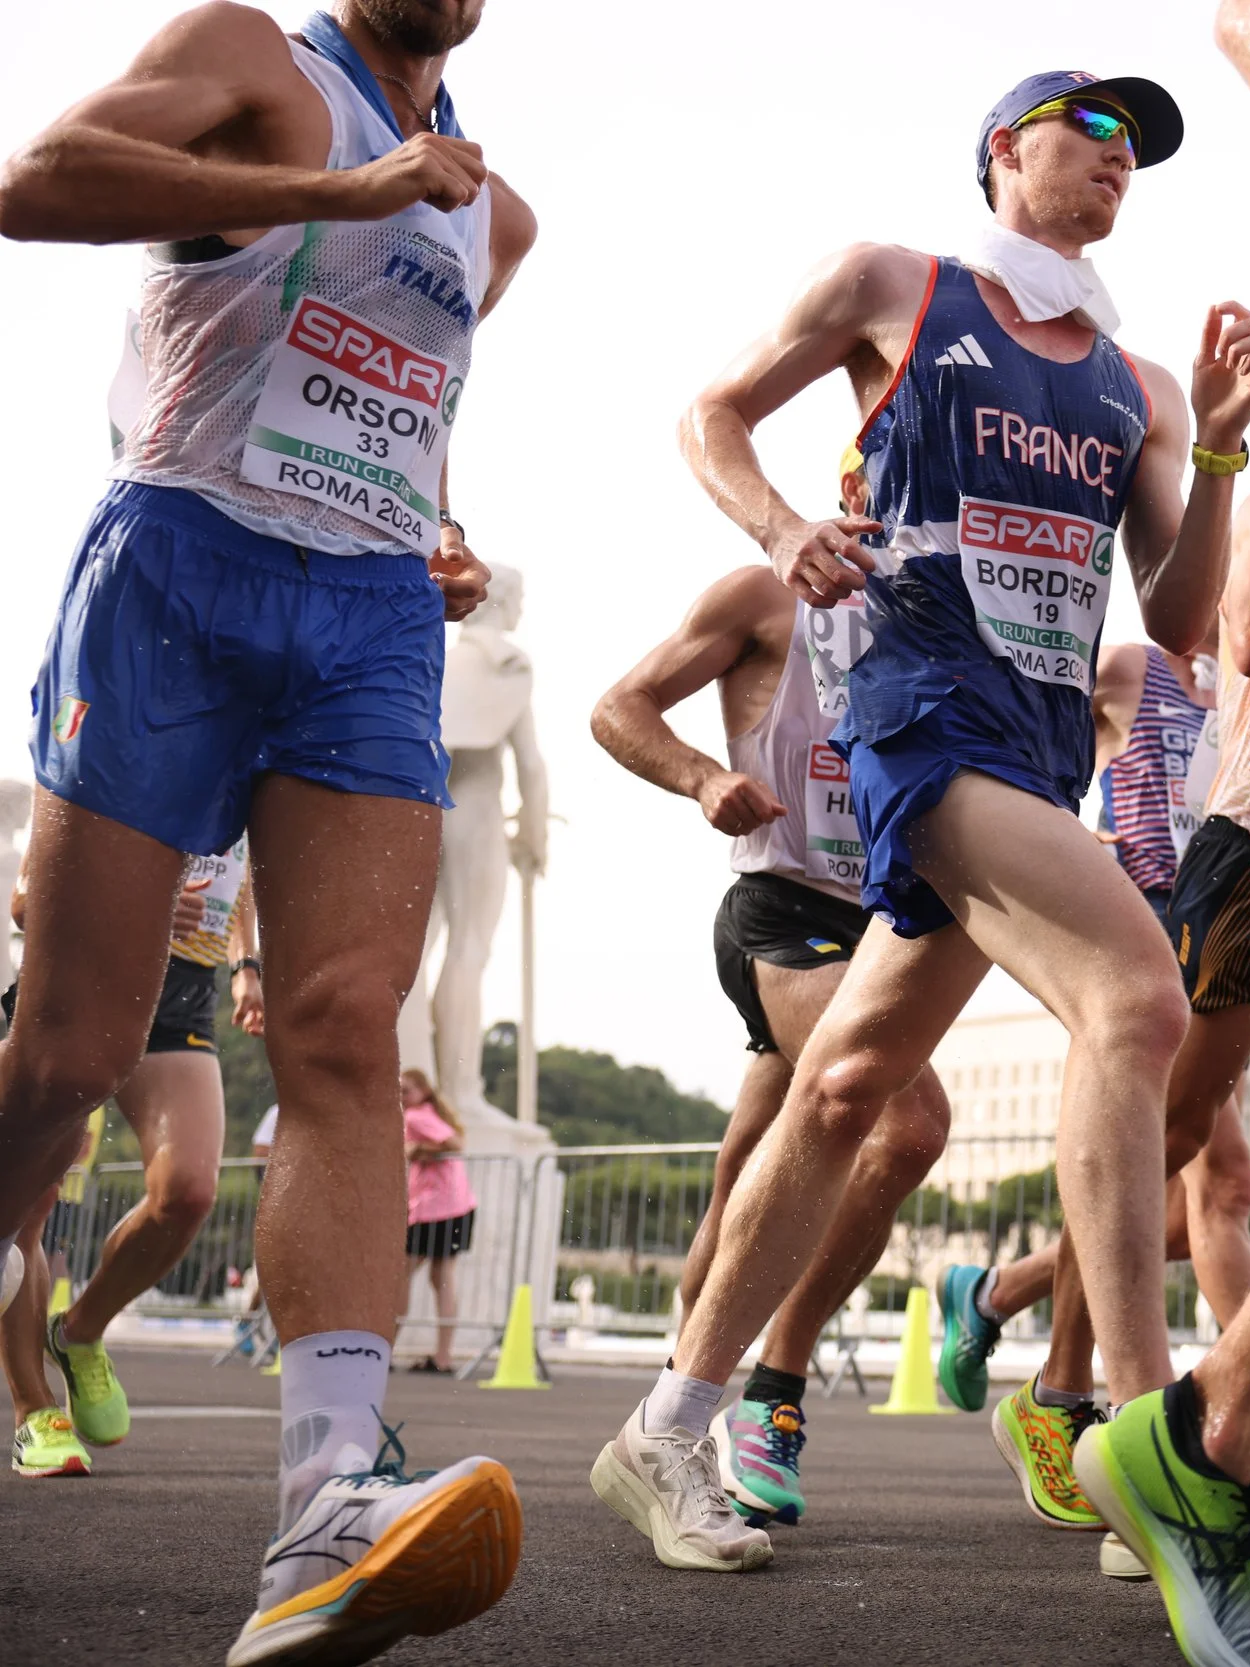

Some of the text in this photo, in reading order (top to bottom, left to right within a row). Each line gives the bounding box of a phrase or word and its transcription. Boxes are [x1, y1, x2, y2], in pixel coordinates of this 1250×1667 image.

[383, 255, 473, 328] ITALIA
[297, 309, 441, 400] SPAR
[302, 373, 439, 456] ORSONI
[300, 444, 306, 457] I
[311, 446, 359, 474] RUN
[357, 432, 389, 459] 33
[975, 407, 1122, 497] FRANCE
[278, 462, 423, 542] ROMA 2024
[964, 509, 1091, 560] SPAR
[976, 558, 1098, 611] BORDIER
[1033, 602, 1060, 624] 19
[1003, 623, 1036, 644] RUN
[1039, 631, 1079, 650] CLEA
[1005, 646, 1048, 675] OMA
[841, 842, 865, 855] RU
[828, 859, 867, 879] ROM
